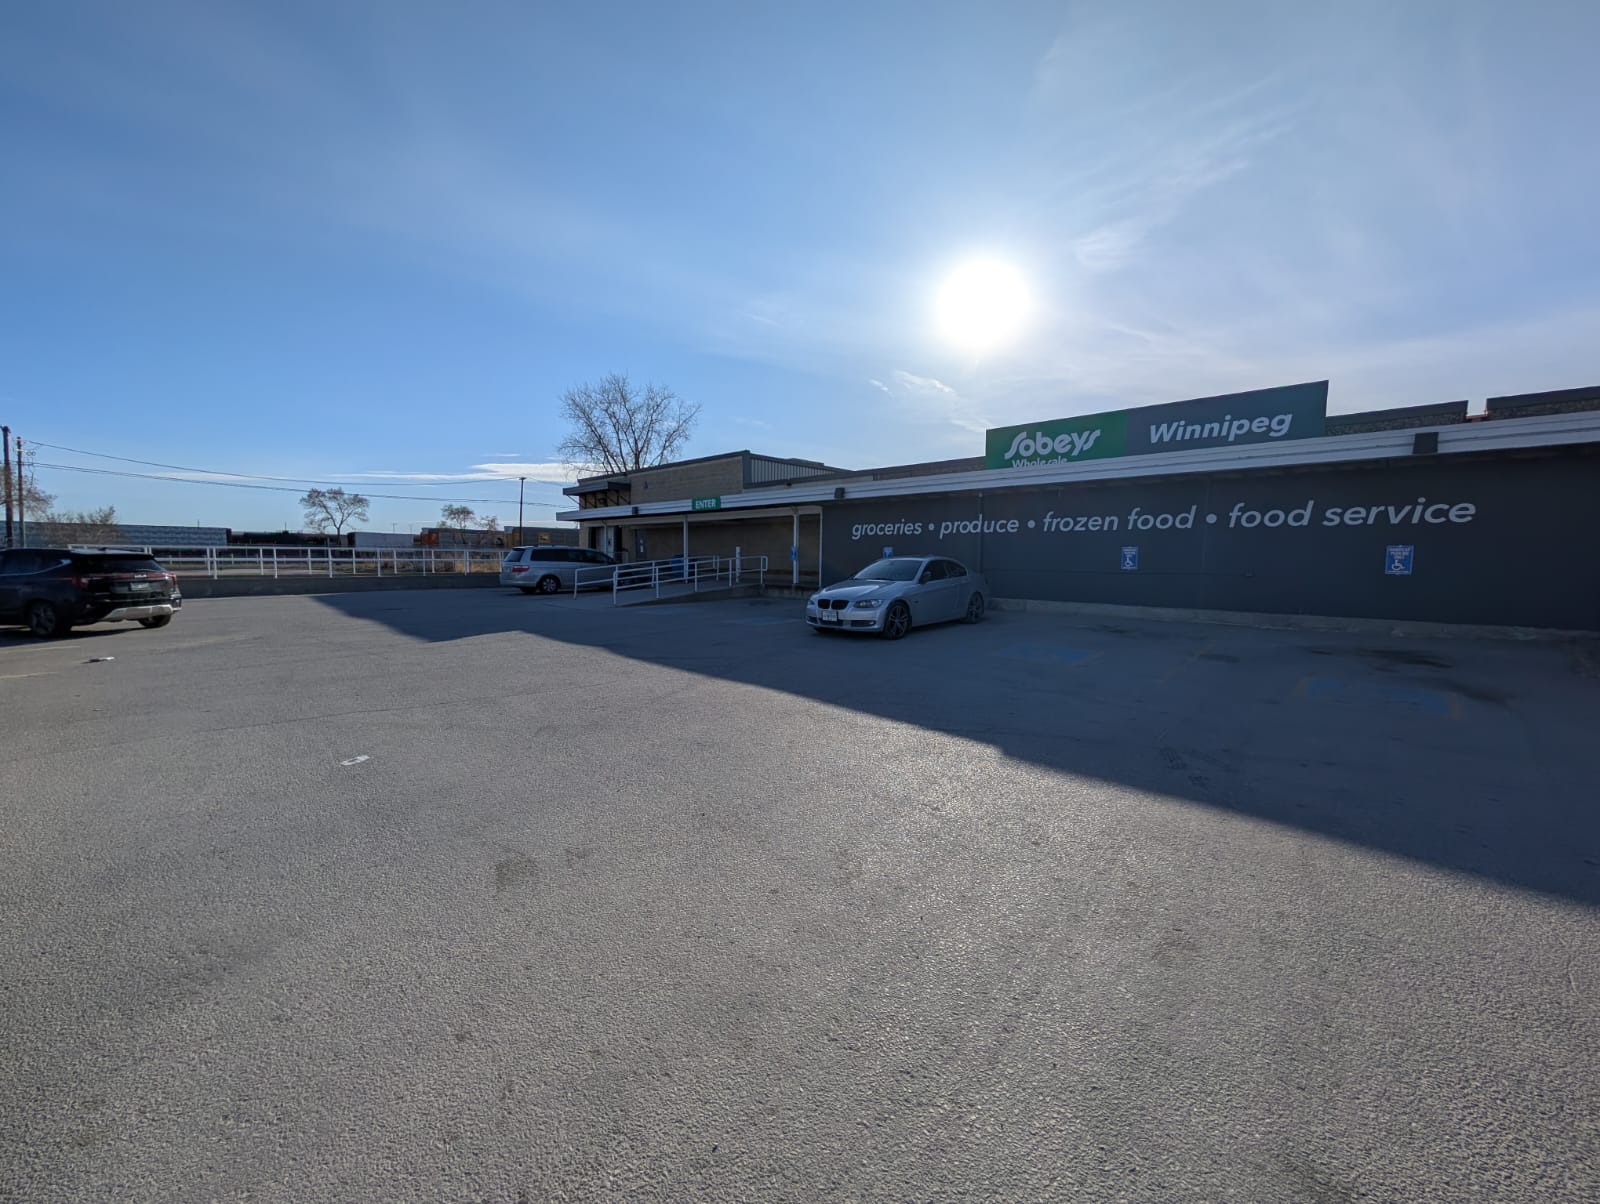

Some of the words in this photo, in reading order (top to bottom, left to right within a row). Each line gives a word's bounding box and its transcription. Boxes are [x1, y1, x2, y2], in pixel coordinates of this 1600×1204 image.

[1150, 414, 1293, 443] Winnipeg
[1004, 430, 1101, 460] Sobeys
[695, 499, 716, 509] ENTER
[851, 518, 922, 540] groceries
[939, 513, 1020, 539] produce
[1043, 511, 1119, 532] frozen
[1127, 505, 1197, 530] food
[1228, 500, 1315, 528] food
[1322, 496, 1477, 526] service
